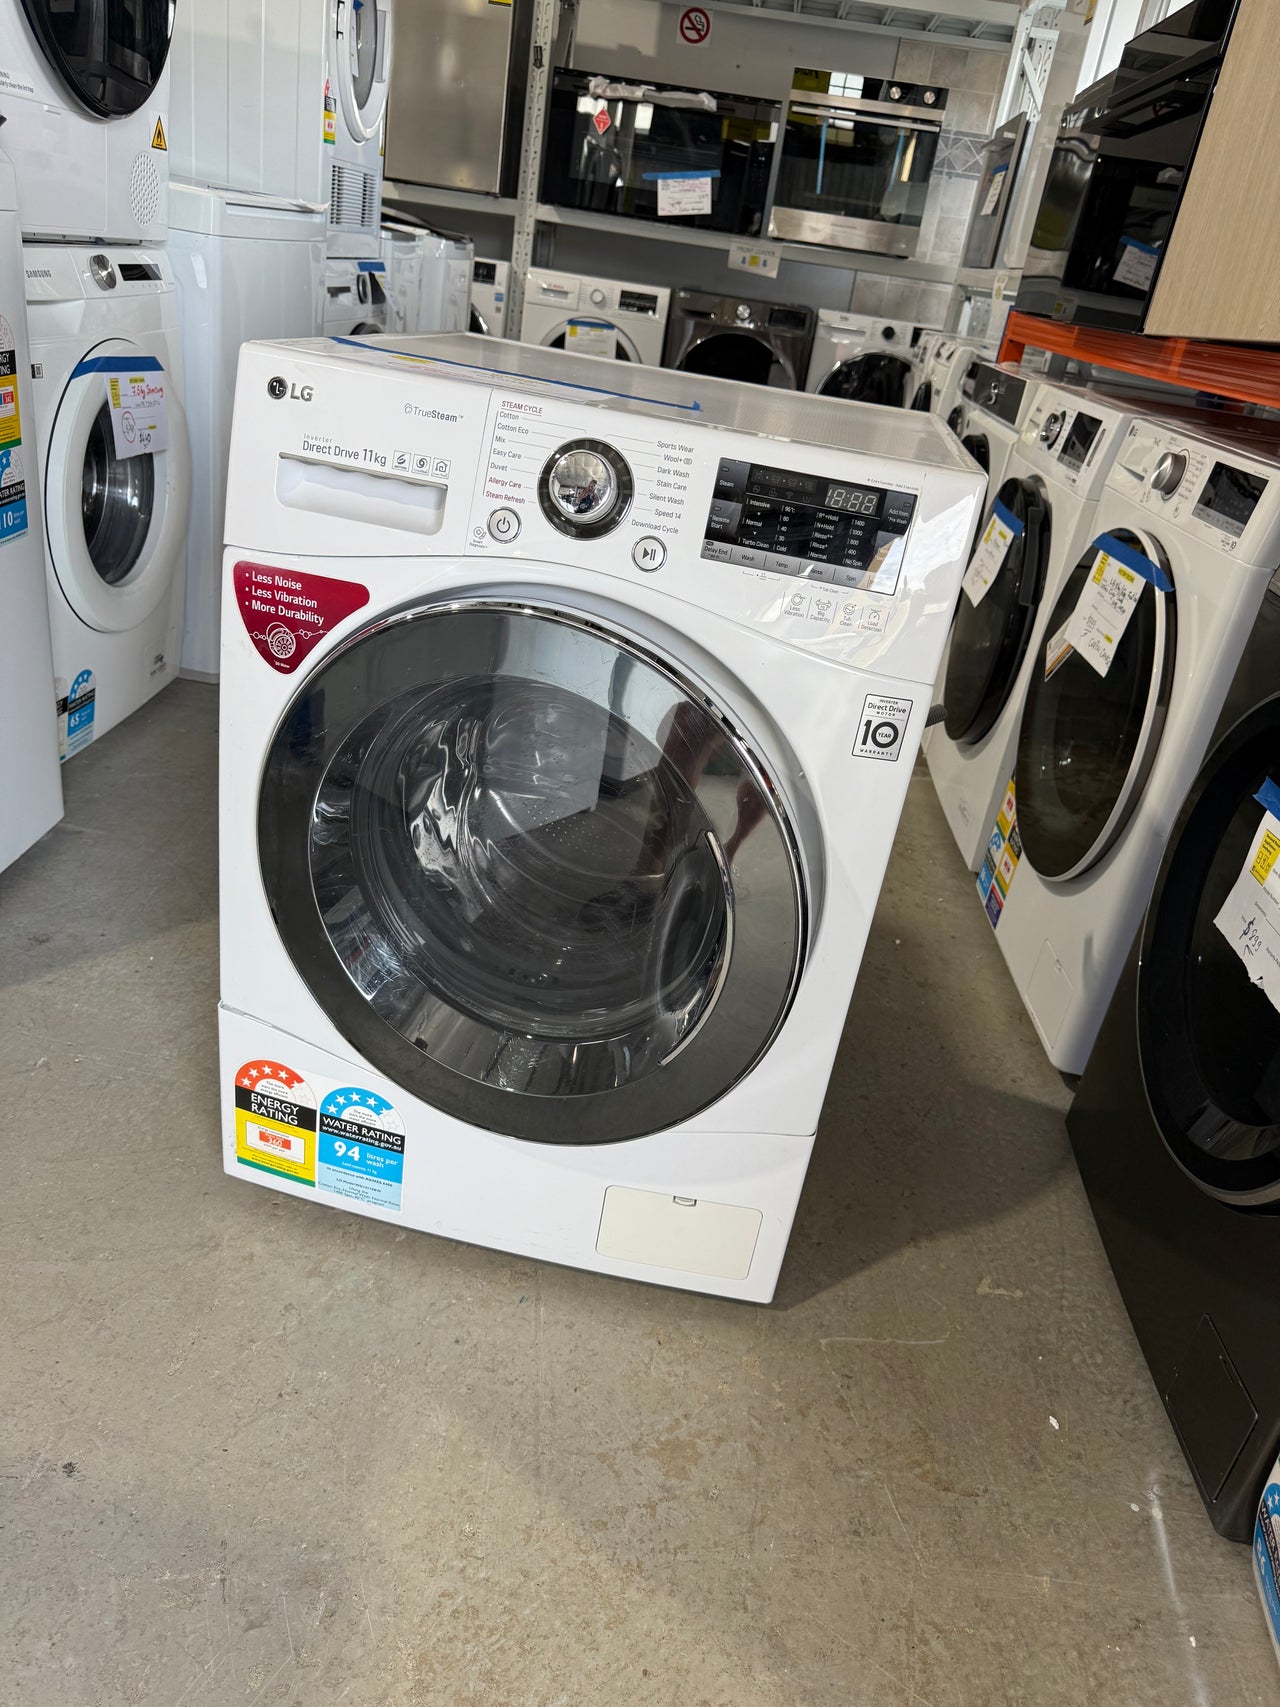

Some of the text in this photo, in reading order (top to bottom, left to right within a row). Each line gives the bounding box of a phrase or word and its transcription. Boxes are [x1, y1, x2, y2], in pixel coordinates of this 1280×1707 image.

[26, 269, 52, 278] SAMSUNG
[290, 382, 314, 401] LG
[502, 400, 543, 414] STEAM CYCLE
[499, 411, 519, 420] Cotton
[497, 423, 517, 432] Cotton
[657, 440, 694, 453] Sports Wear
[303, 440, 387, 466] Direct Drive 11kg
[493, 448, 522, 459] Easy Care
[490, 462, 508, 471] Duvet
[657, 466, 690, 478] Dark Wash
[488, 476, 522, 489] Allergy Care
[656, 480, 687, 491] Stain Care
[0, 482, 24, 498] ATER RATING
[486, 491, 526, 504] Steam Refresh
[649, 493, 684, 505] Silent Wash
[750, 500, 771, 508] Intensive
[654, 509, 674, 517] Speed
[631, 519, 679, 534] Download Cycle
[746, 518, 762, 527] Normal
[704, 546, 718, 554] Delay
[756, 541, 770, 549] Clean
[810, 551, 828, 560] Normal
[776, 561, 789, 569] Temp
[252, 571, 302, 590] Less Noise
[252, 585, 318, 608] Less Vibration
[252, 600, 324, 626] More Durability
[784, 609, 804, 618] Vibration
[810, 614, 830, 624] Capacity
[860, 624, 882, 632] Detection
[868, 702, 907, 714] Direct Drive
[861, 720, 899, 748] 10
[860, 748, 893, 757] WARRANTY
[251, 1093, 299, 1115] ENERGY
[251, 1103, 298, 1125] RATING
[323, 1116, 402, 1145] WATER RATING
[322, 1125, 402, 1151] www.waterrating.gov.au
[334, 1141, 360, 1161] 94
[366, 1152, 398, 1166] litres per
[366, 1160, 384, 1168] wash
